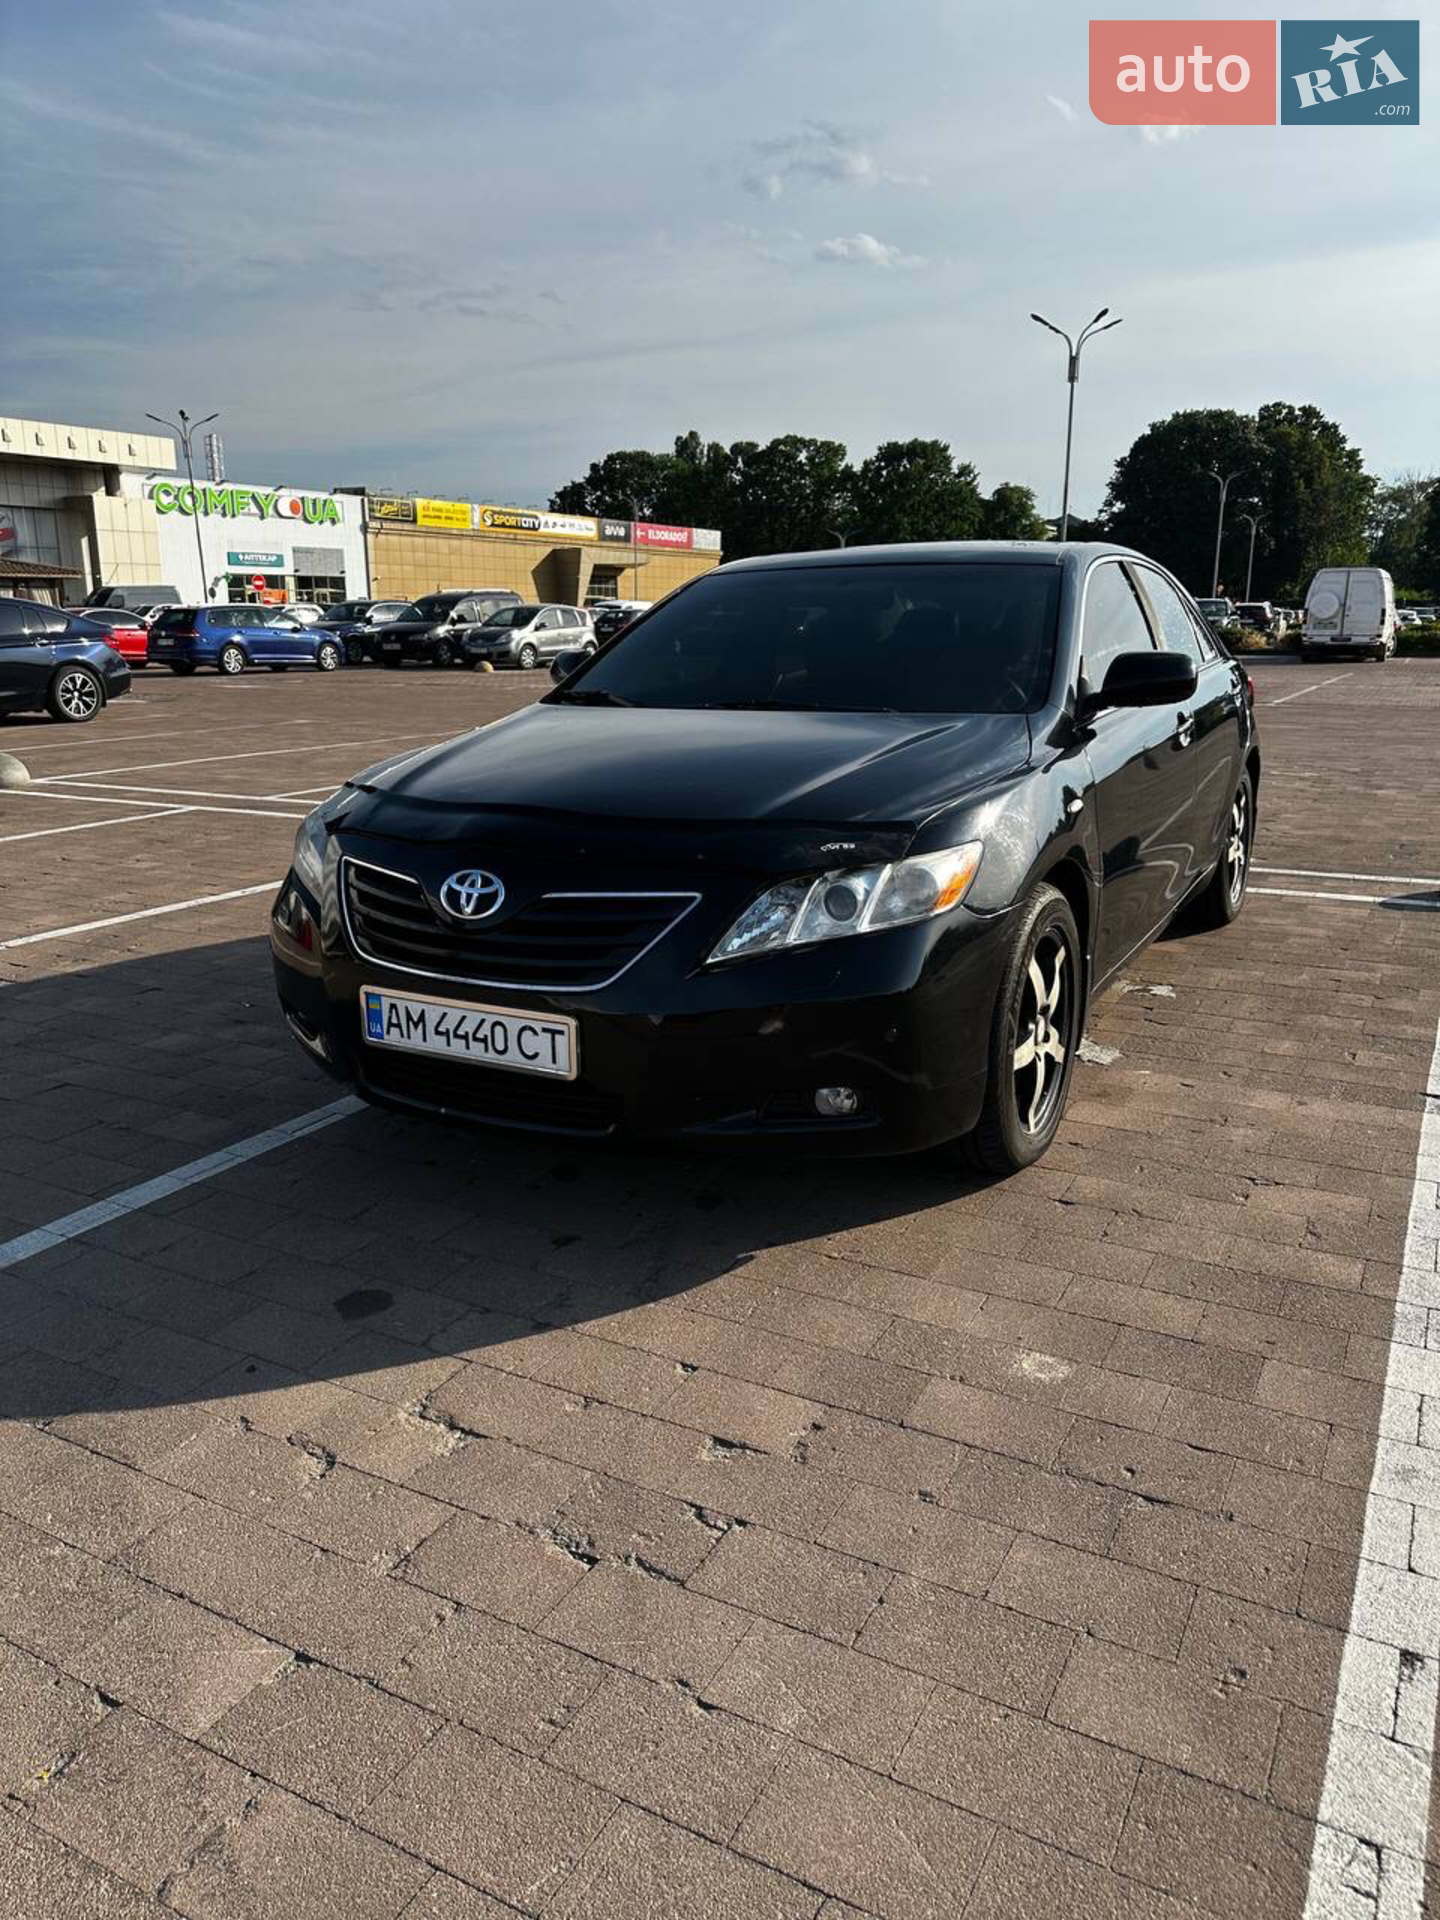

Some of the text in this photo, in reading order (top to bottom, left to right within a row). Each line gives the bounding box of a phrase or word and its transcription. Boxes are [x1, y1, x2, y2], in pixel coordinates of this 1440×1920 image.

[369, 1022, 383, 1035] UA
[386, 1003, 566, 1065] AM 4440 CT
